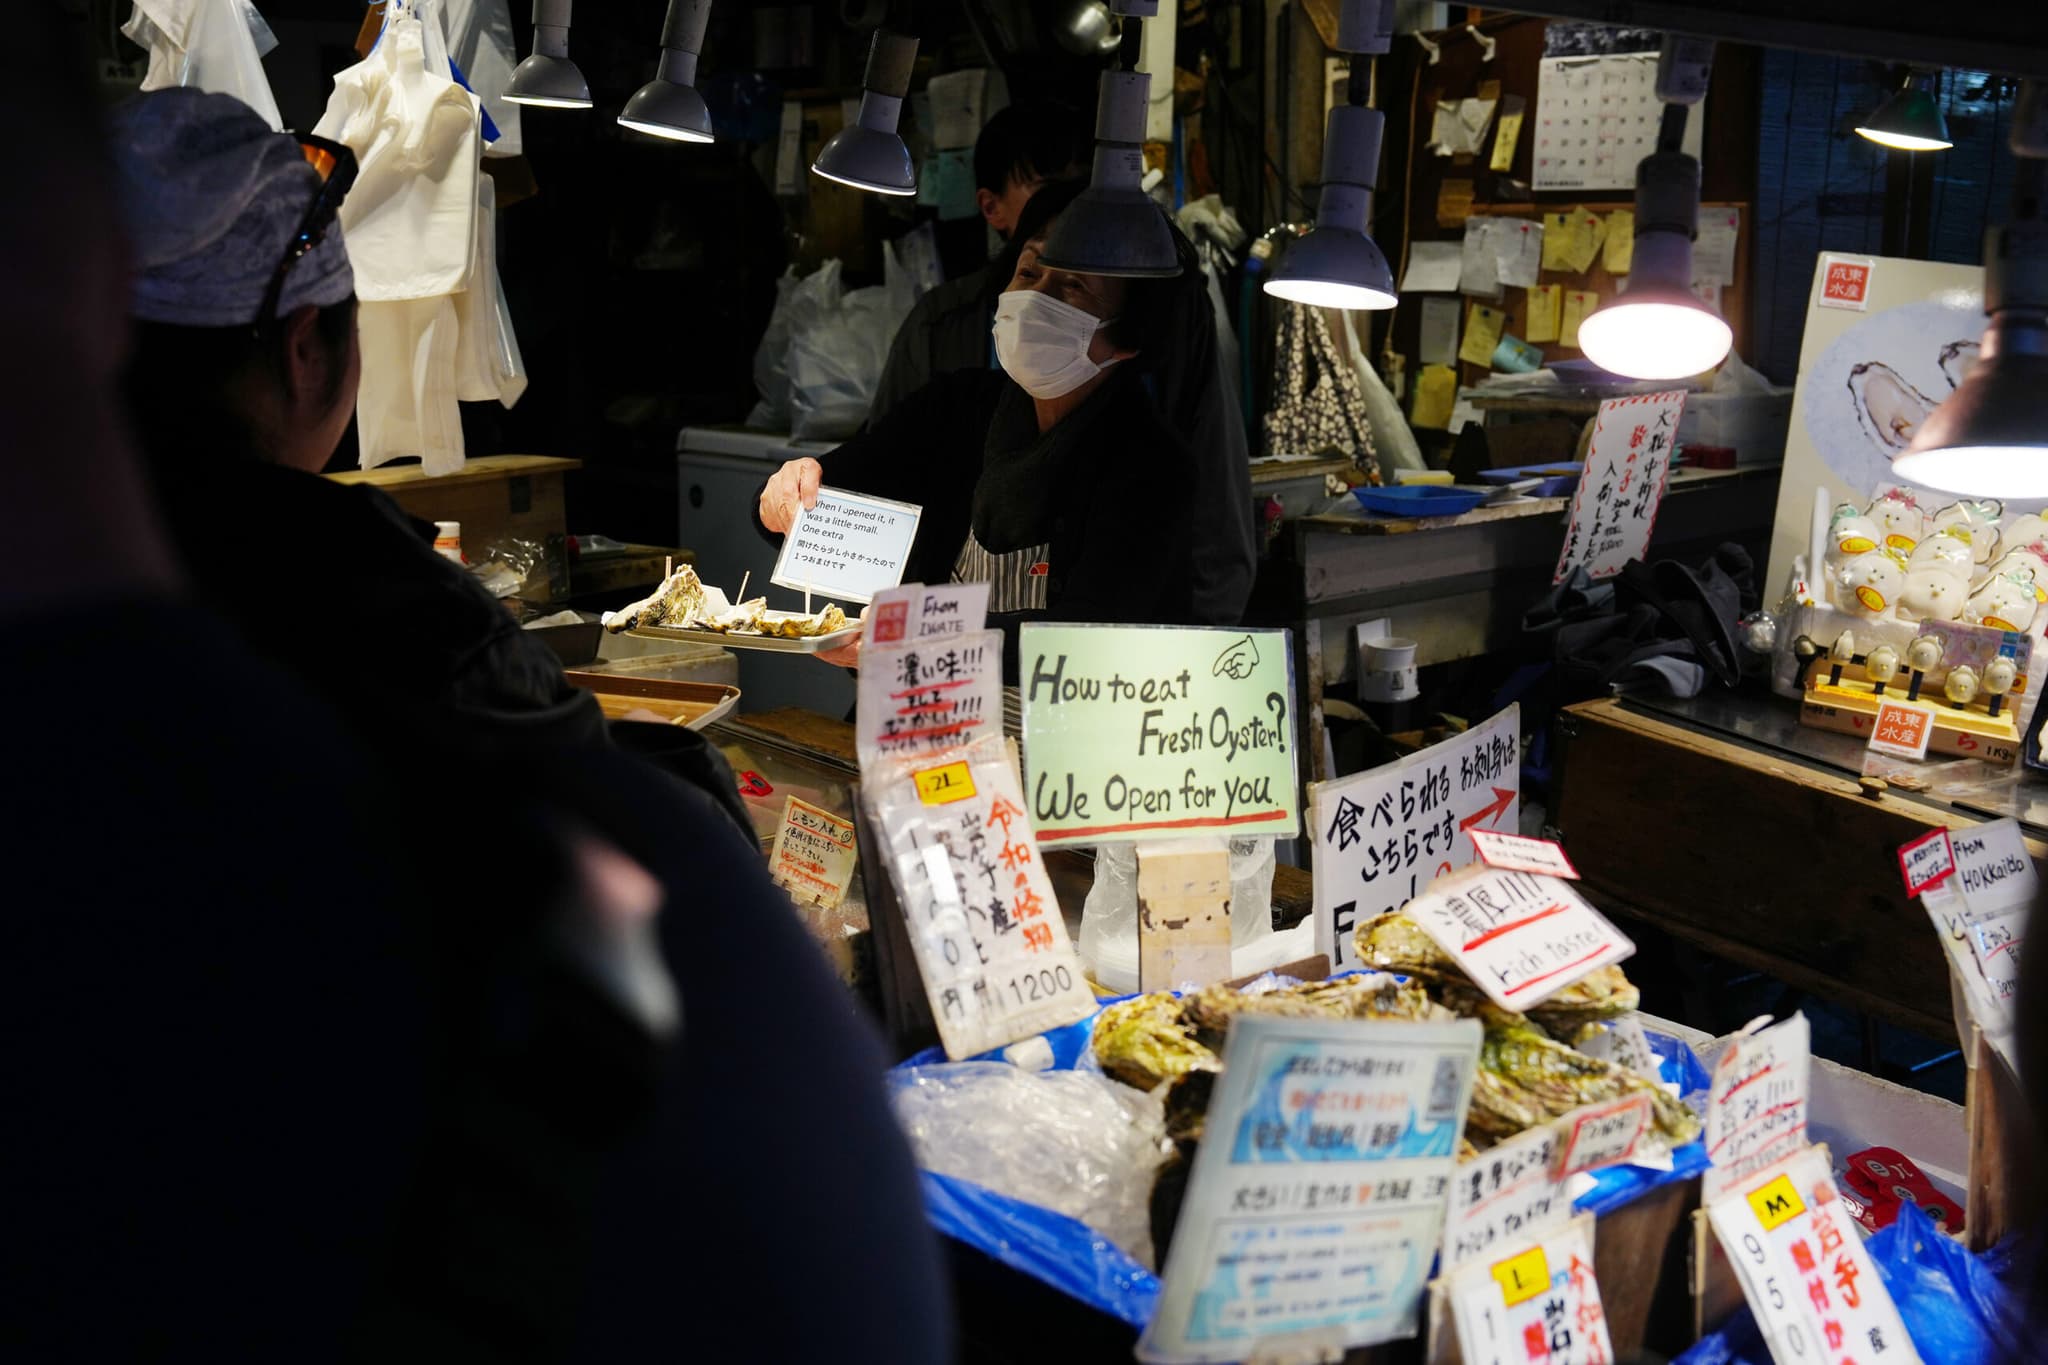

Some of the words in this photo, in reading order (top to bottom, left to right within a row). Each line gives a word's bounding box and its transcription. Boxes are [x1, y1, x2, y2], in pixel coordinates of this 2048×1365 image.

[801, 524, 820, 535] One
[822, 530, 844, 541] extra
[806, 513, 823, 523] was
[825, 516, 831, 524] a
[832, 516, 852, 529] little
[854, 522, 879, 535] small.
[842, 507, 876, 521] opened
[877, 514, 886, 524] it,
[888, 517, 895, 525] it
[1029, 654, 1100, 704] How
[1107, 673, 1136, 703] to
[1140, 669, 1191, 703] eat
[1138, 709, 1202, 756] Fresh
[1209, 691, 1286, 763] Oyster?
[1035, 771, 1091, 821] We
[1104, 774, 1171, 821] Open
[1179, 768, 1216, 808] for
[1361, 809, 1455, 883] こちらです
[1008, 964, 1073, 1006] 1200
[1767, 1194, 1791, 1217] M
